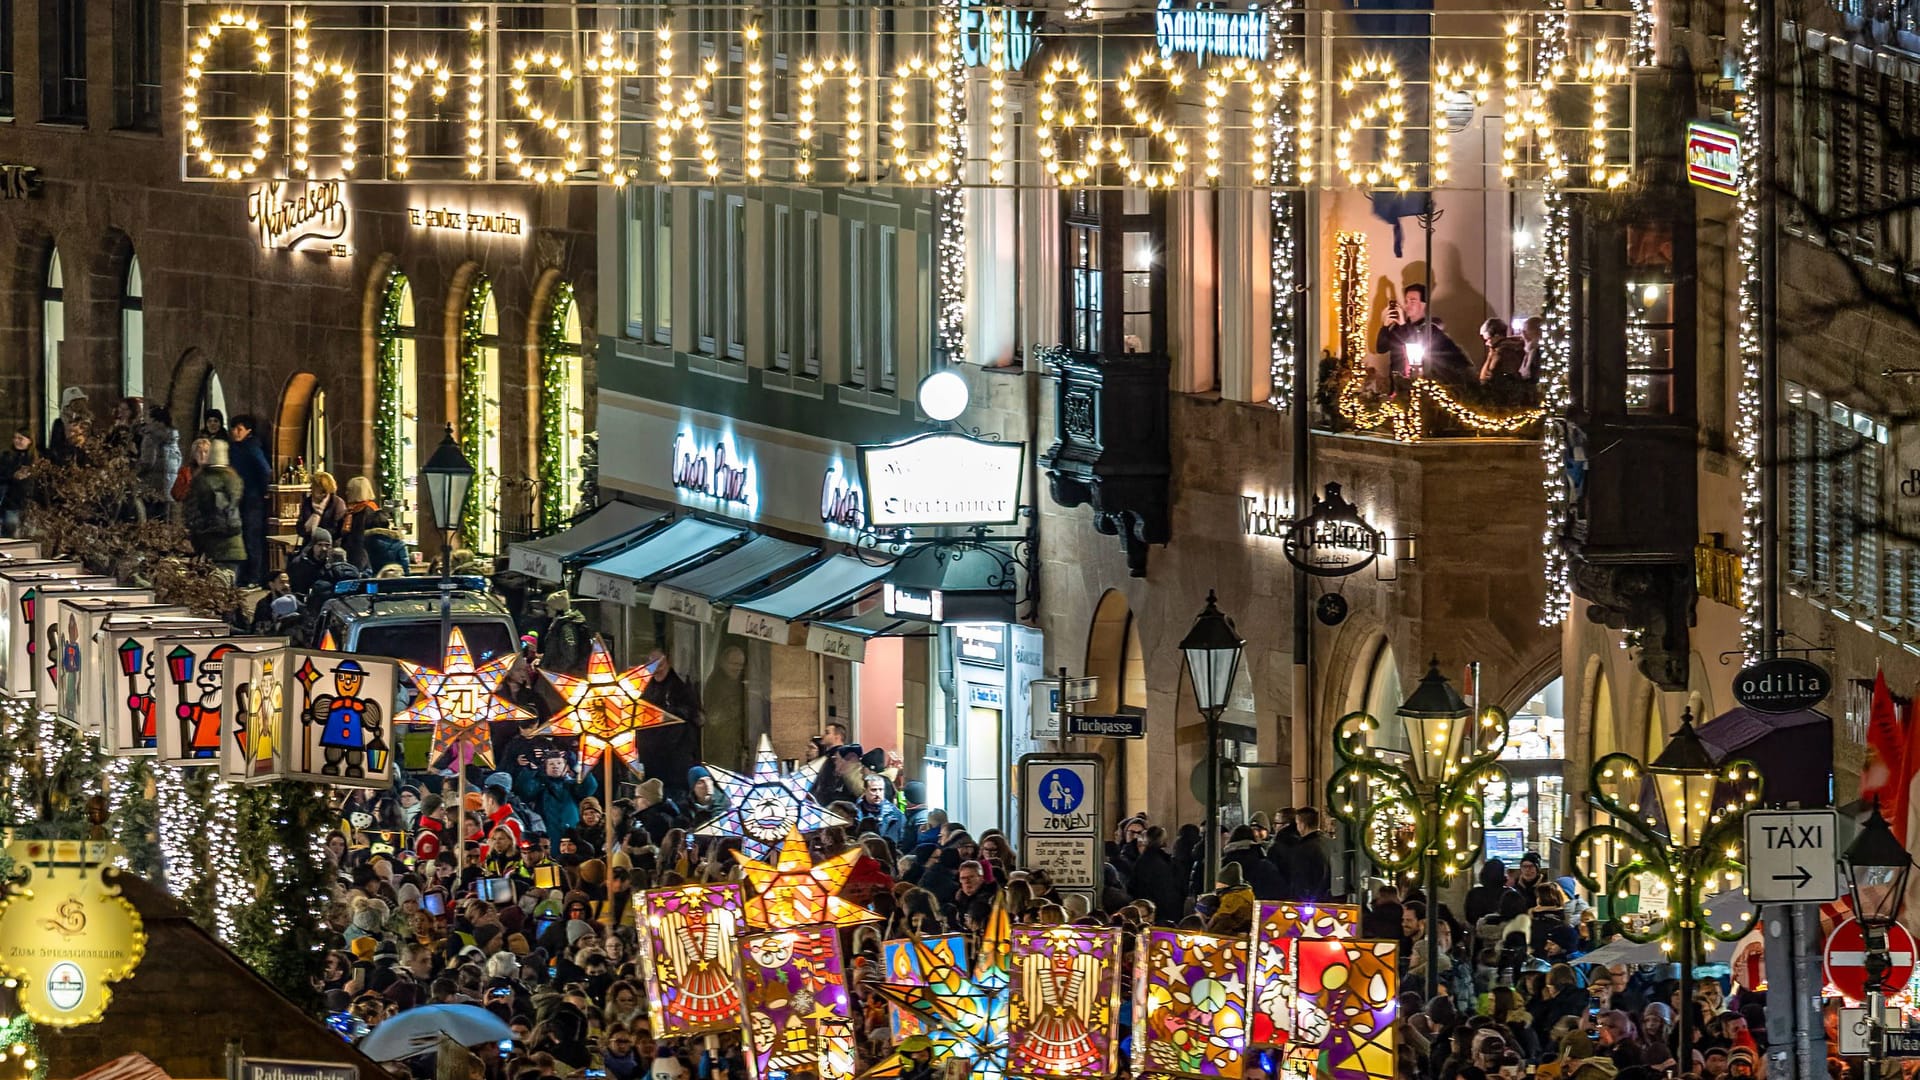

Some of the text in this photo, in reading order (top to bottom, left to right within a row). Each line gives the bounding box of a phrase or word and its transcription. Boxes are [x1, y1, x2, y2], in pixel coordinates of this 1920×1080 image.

[1742, 673, 1820, 693] odilia
[1076, 719, 1132, 734] Tuchgasse
[1761, 825, 1822, 849] TAXI
